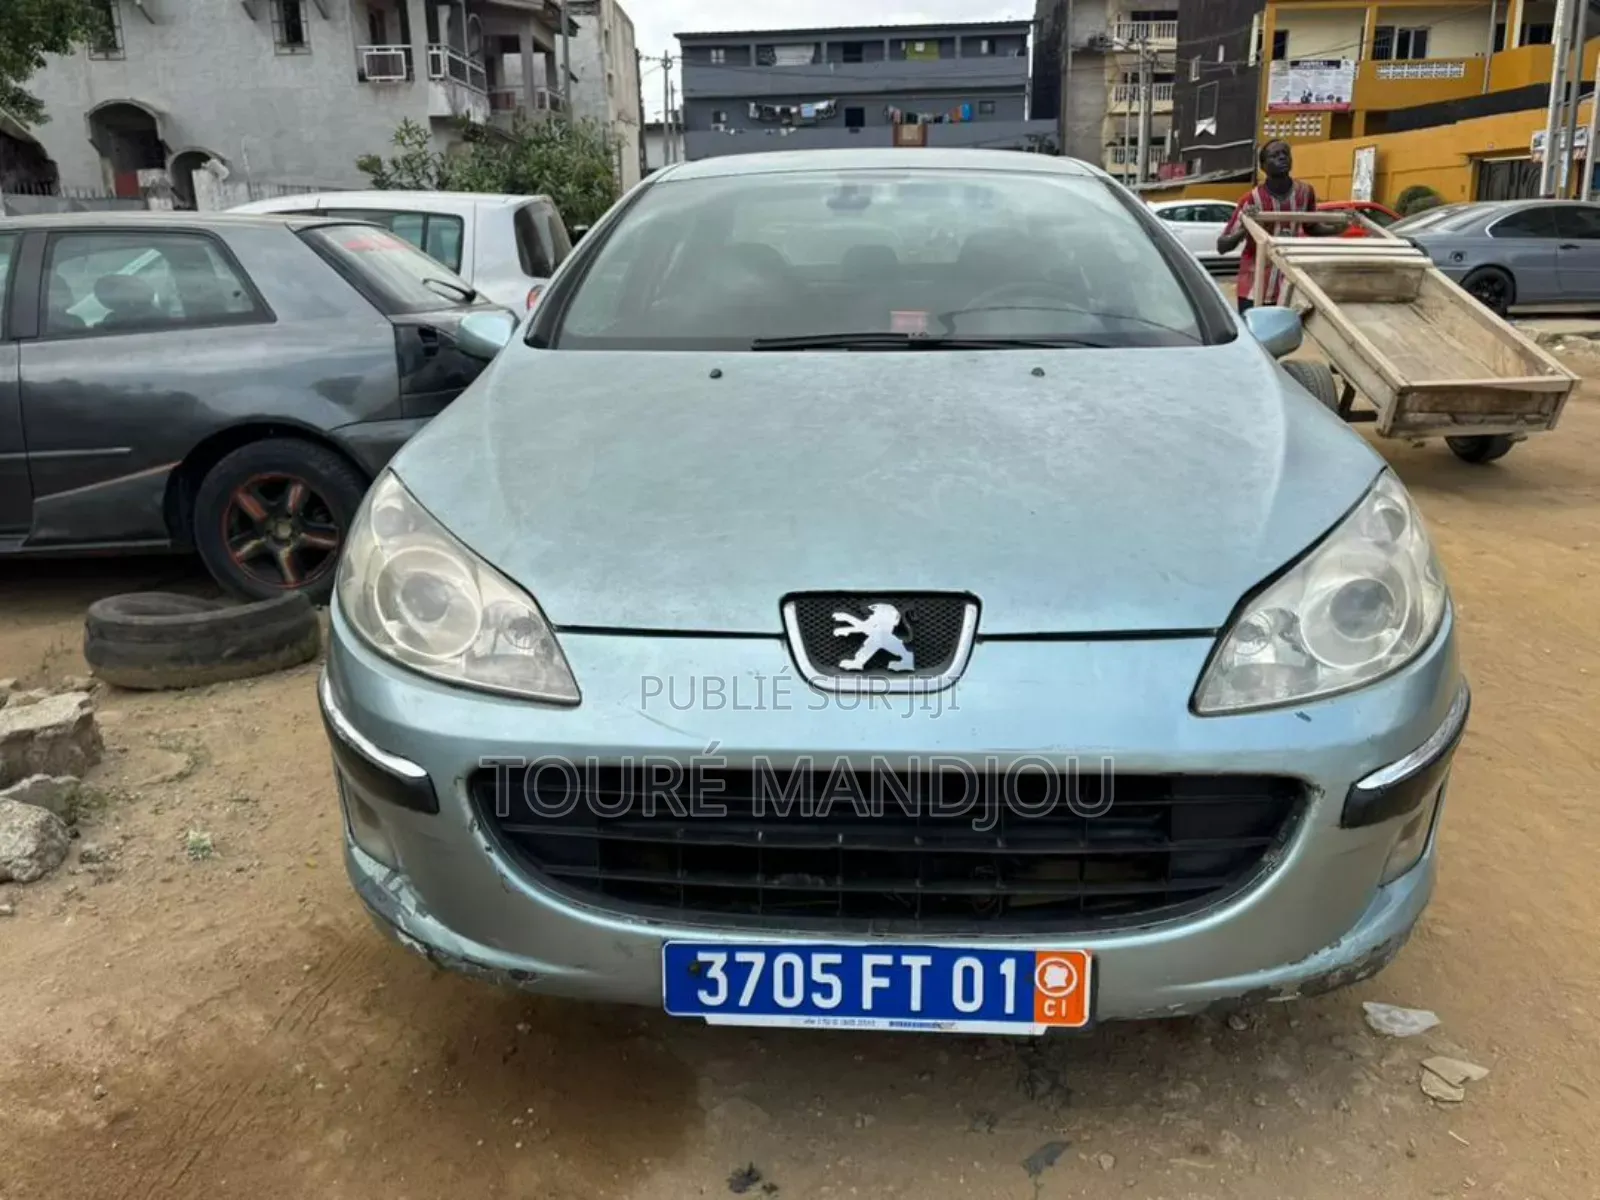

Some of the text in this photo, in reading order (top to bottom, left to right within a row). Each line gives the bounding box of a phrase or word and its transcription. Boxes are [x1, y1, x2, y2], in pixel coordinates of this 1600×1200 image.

[696, 951, 1016, 1015] 3705 FT 01
[1043, 998, 1068, 1018] CI
